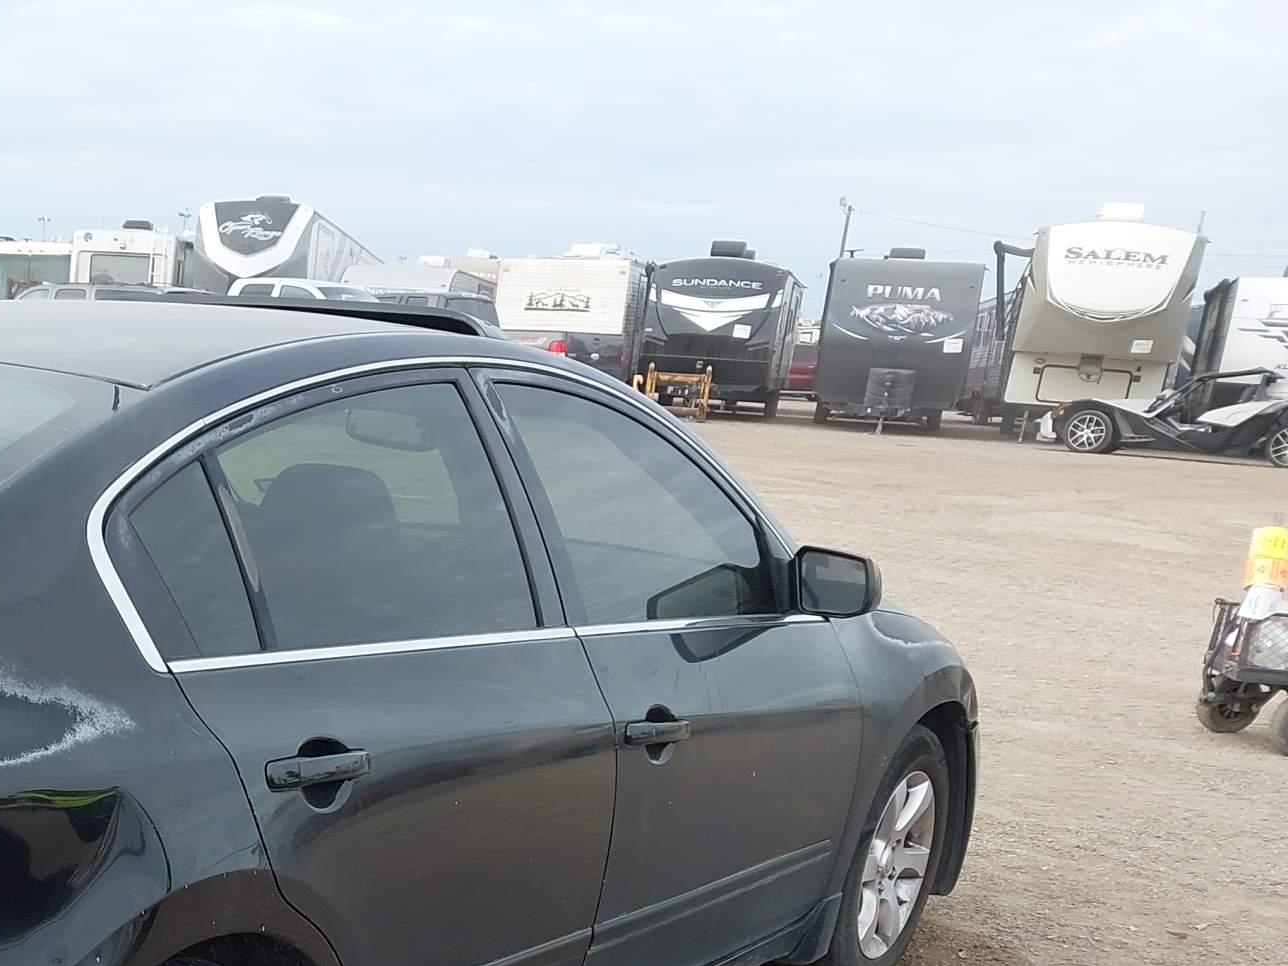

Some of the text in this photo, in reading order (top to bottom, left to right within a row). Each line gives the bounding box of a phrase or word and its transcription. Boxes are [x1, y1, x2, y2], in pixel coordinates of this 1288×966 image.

[1064, 246, 1170, 265] SALEM
[672, 278, 764, 290] SUNDANCE
[867, 284, 941, 302] PUMA
